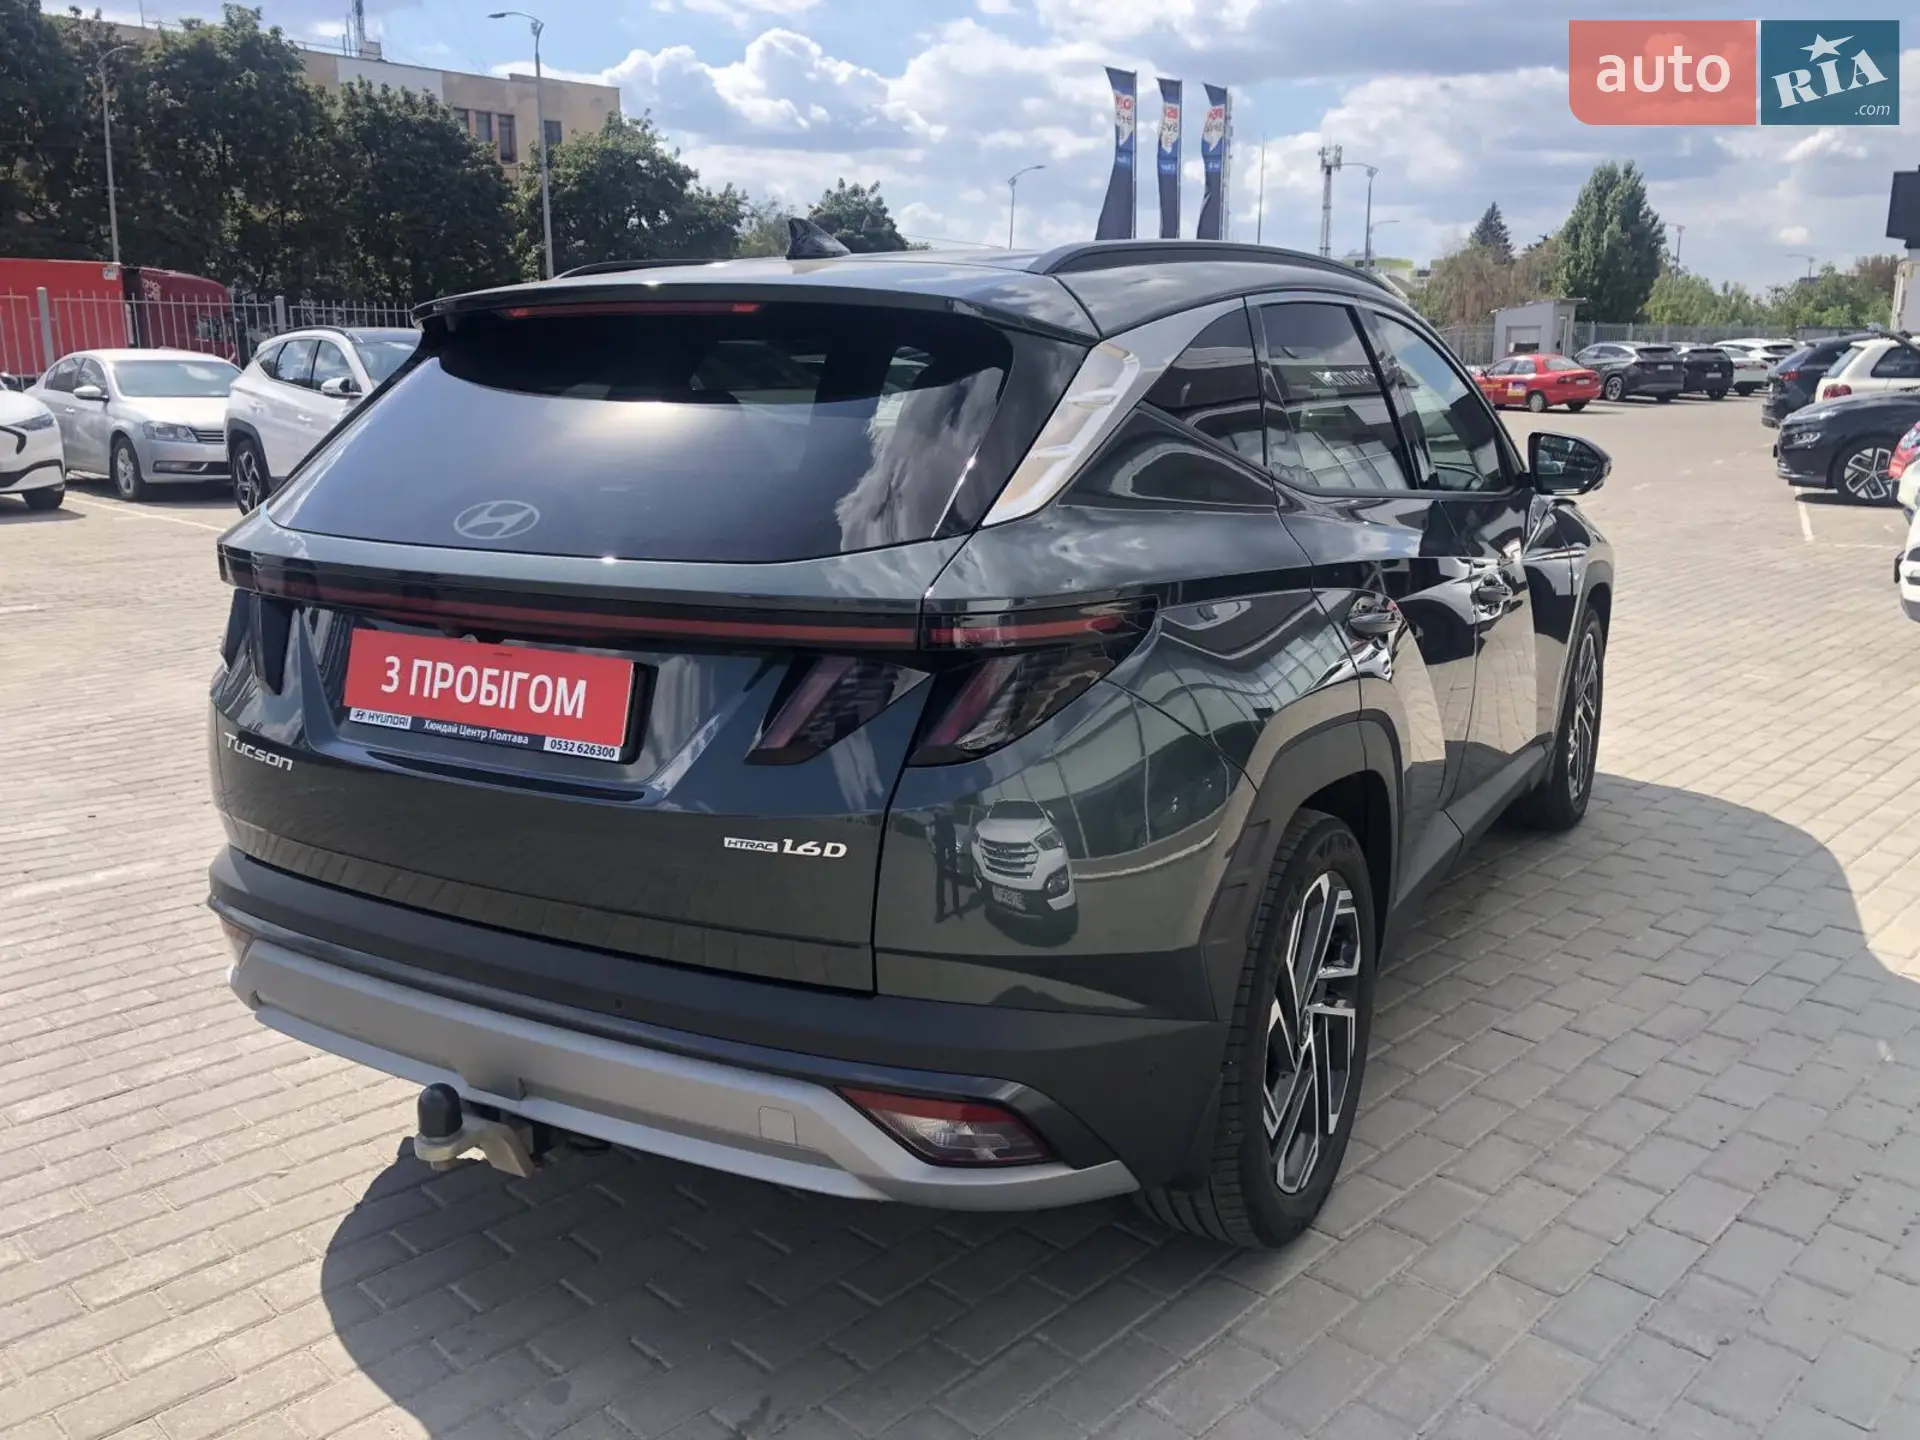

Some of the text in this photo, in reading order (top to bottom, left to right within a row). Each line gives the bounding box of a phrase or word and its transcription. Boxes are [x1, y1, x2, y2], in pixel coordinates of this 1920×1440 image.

[409, 659, 587, 719] ПРОБІГОМ
[368, 711, 409, 728] HYUNDAI
[423, 719, 529, 745] Хюндай Центр Полтава
[550, 738, 616, 759] 0532 626300
[726, 839, 776, 852] HTRAC
